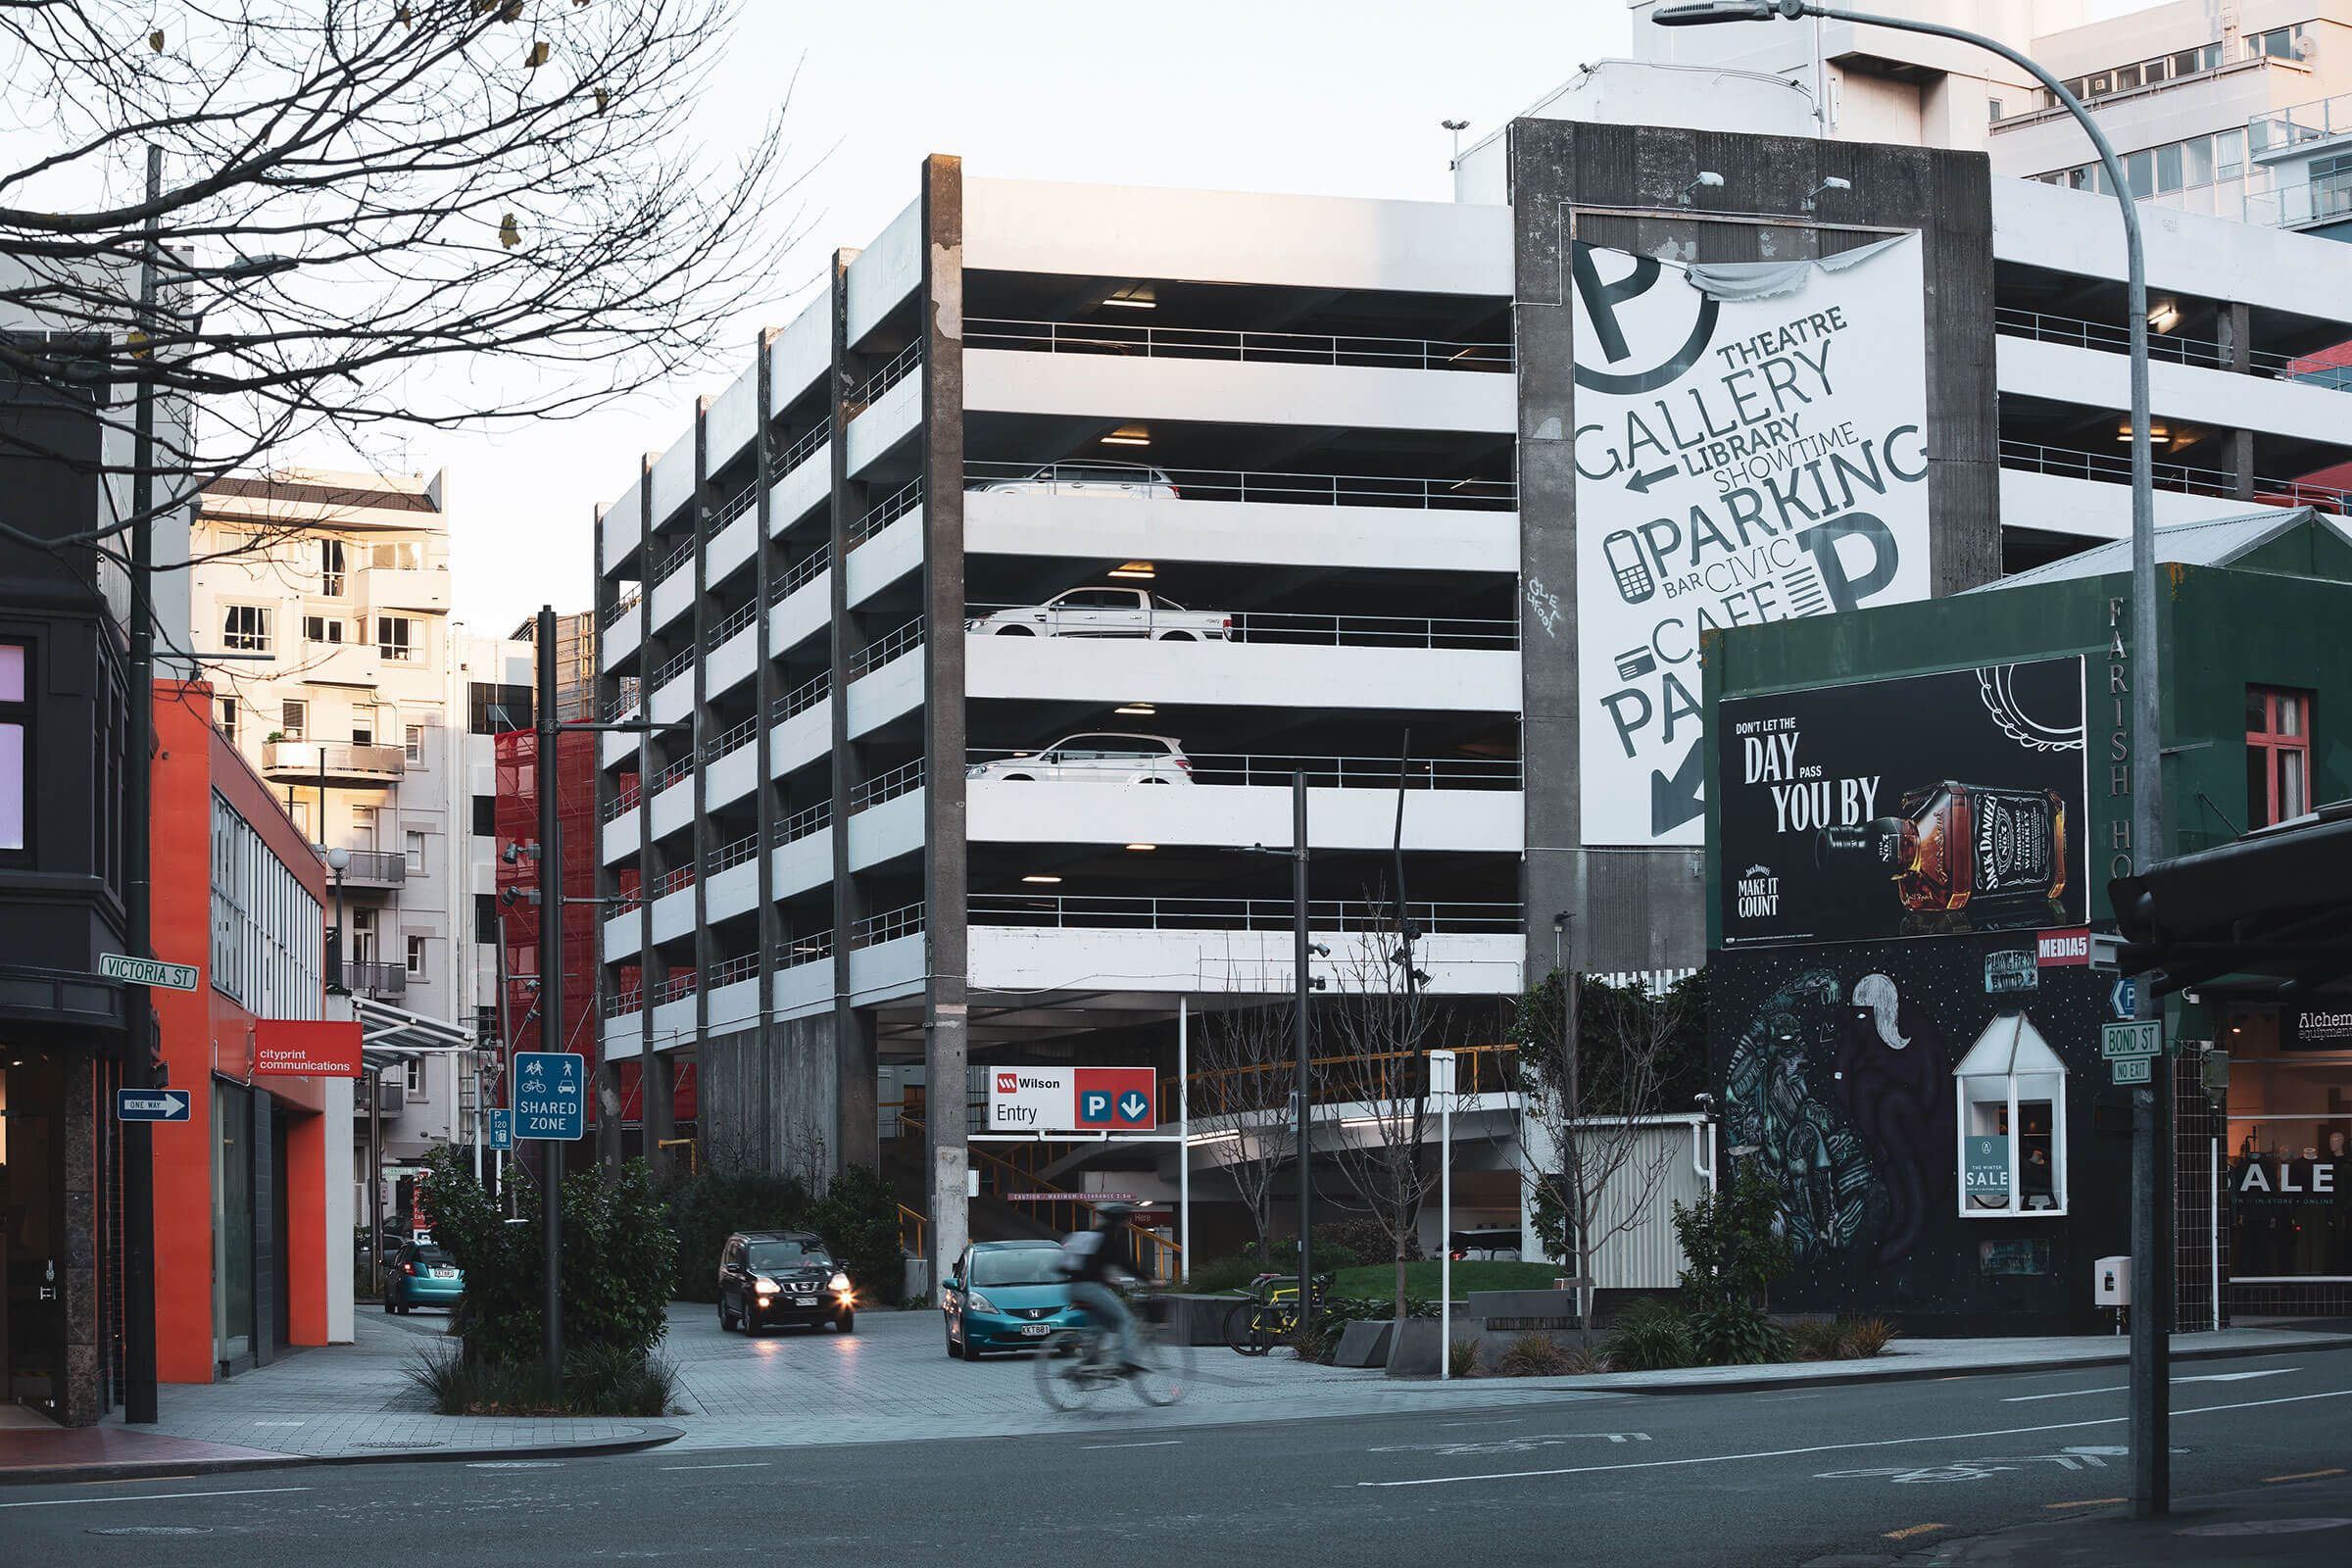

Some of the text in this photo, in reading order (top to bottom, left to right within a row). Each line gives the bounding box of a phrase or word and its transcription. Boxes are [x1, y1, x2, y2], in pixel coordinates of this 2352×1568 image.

[1716, 306, 1847, 369] THEATRE
[1576, 338, 1834, 480] GALLERY
[1681, 413, 1800, 477] LIBRARY
[1714, 421, 1859, 493] SHOWTIME
[1637, 424, 1929, 578] PARKING
[1662, 538, 1797, 599] BAR CIVIC
[2107, 596, 2130, 797] FARISH
[1736, 717, 1796, 735] DON'T LET THE
[1744, 732, 1800, 784] DAY
[1799, 765, 1822, 779] PASS
[1771, 776, 1881, 833] YOU BY
[1739, 877, 1779, 897] MAKE IT
[1739, 895, 1779, 918] COUNT
[2038, 937, 2087, 958] MEDIA5
[107, 958, 189, 985] VICTORIA ST
[2109, 1027, 2155, 1053] BOND ST
[260, 1049, 306, 1060] cityprint
[260, 1060, 351, 1071] communications
[2117, 1061, 2146, 1078] NO EXIT
[1018, 1078, 1060, 1089] Wilson
[129, 1100, 161, 1110] ONE WAY
[494, 1110, 502, 1120] P
[520, 1102, 576, 1114] SHARED
[997, 1104, 1037, 1124] Entry
[530, 1117, 566, 1130] ZONE
[1967, 1172, 2007, 1186] SALE
[2228, 1163, 2334, 1192] ALE
